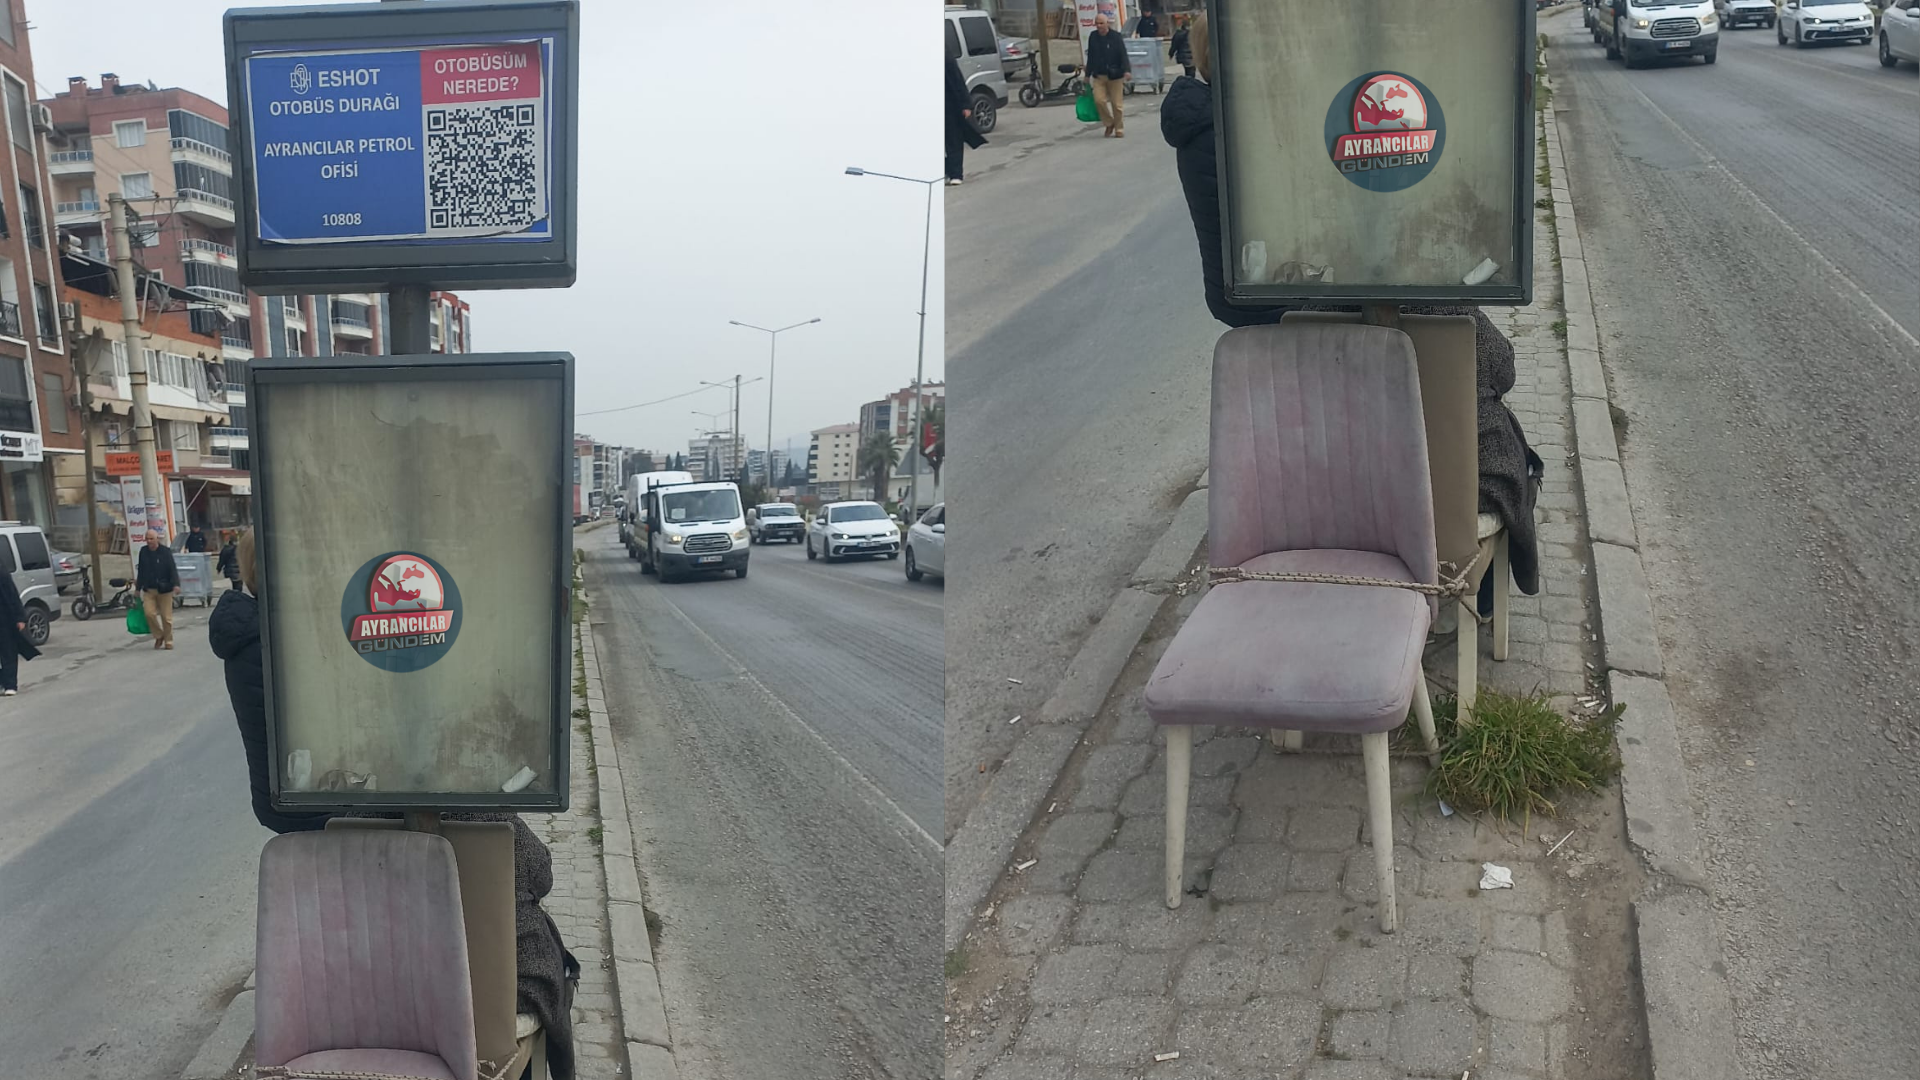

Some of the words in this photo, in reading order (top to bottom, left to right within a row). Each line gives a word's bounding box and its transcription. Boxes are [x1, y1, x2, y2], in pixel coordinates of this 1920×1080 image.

[434, 51, 528, 75] OTOBÜSÜM
[318, 68, 381, 88] ESHOT
[443, 76, 519, 96] NEREDE?
[269, 96, 335, 117] OTOBÜS
[339, 92, 400, 114] DURAĞI
[264, 139, 355, 158] AYRANCILAR
[359, 136, 415, 154] PETROL
[1343, 135, 1429, 157] AYRANCILAR
[321, 160, 359, 179] OFİSİ
[1340, 152, 1429, 174] GÜNDEM
[322, 212, 362, 227] 10808
[360, 615, 446, 637] AYRANCILAR
[357, 632, 446, 654] GÜNDEM
